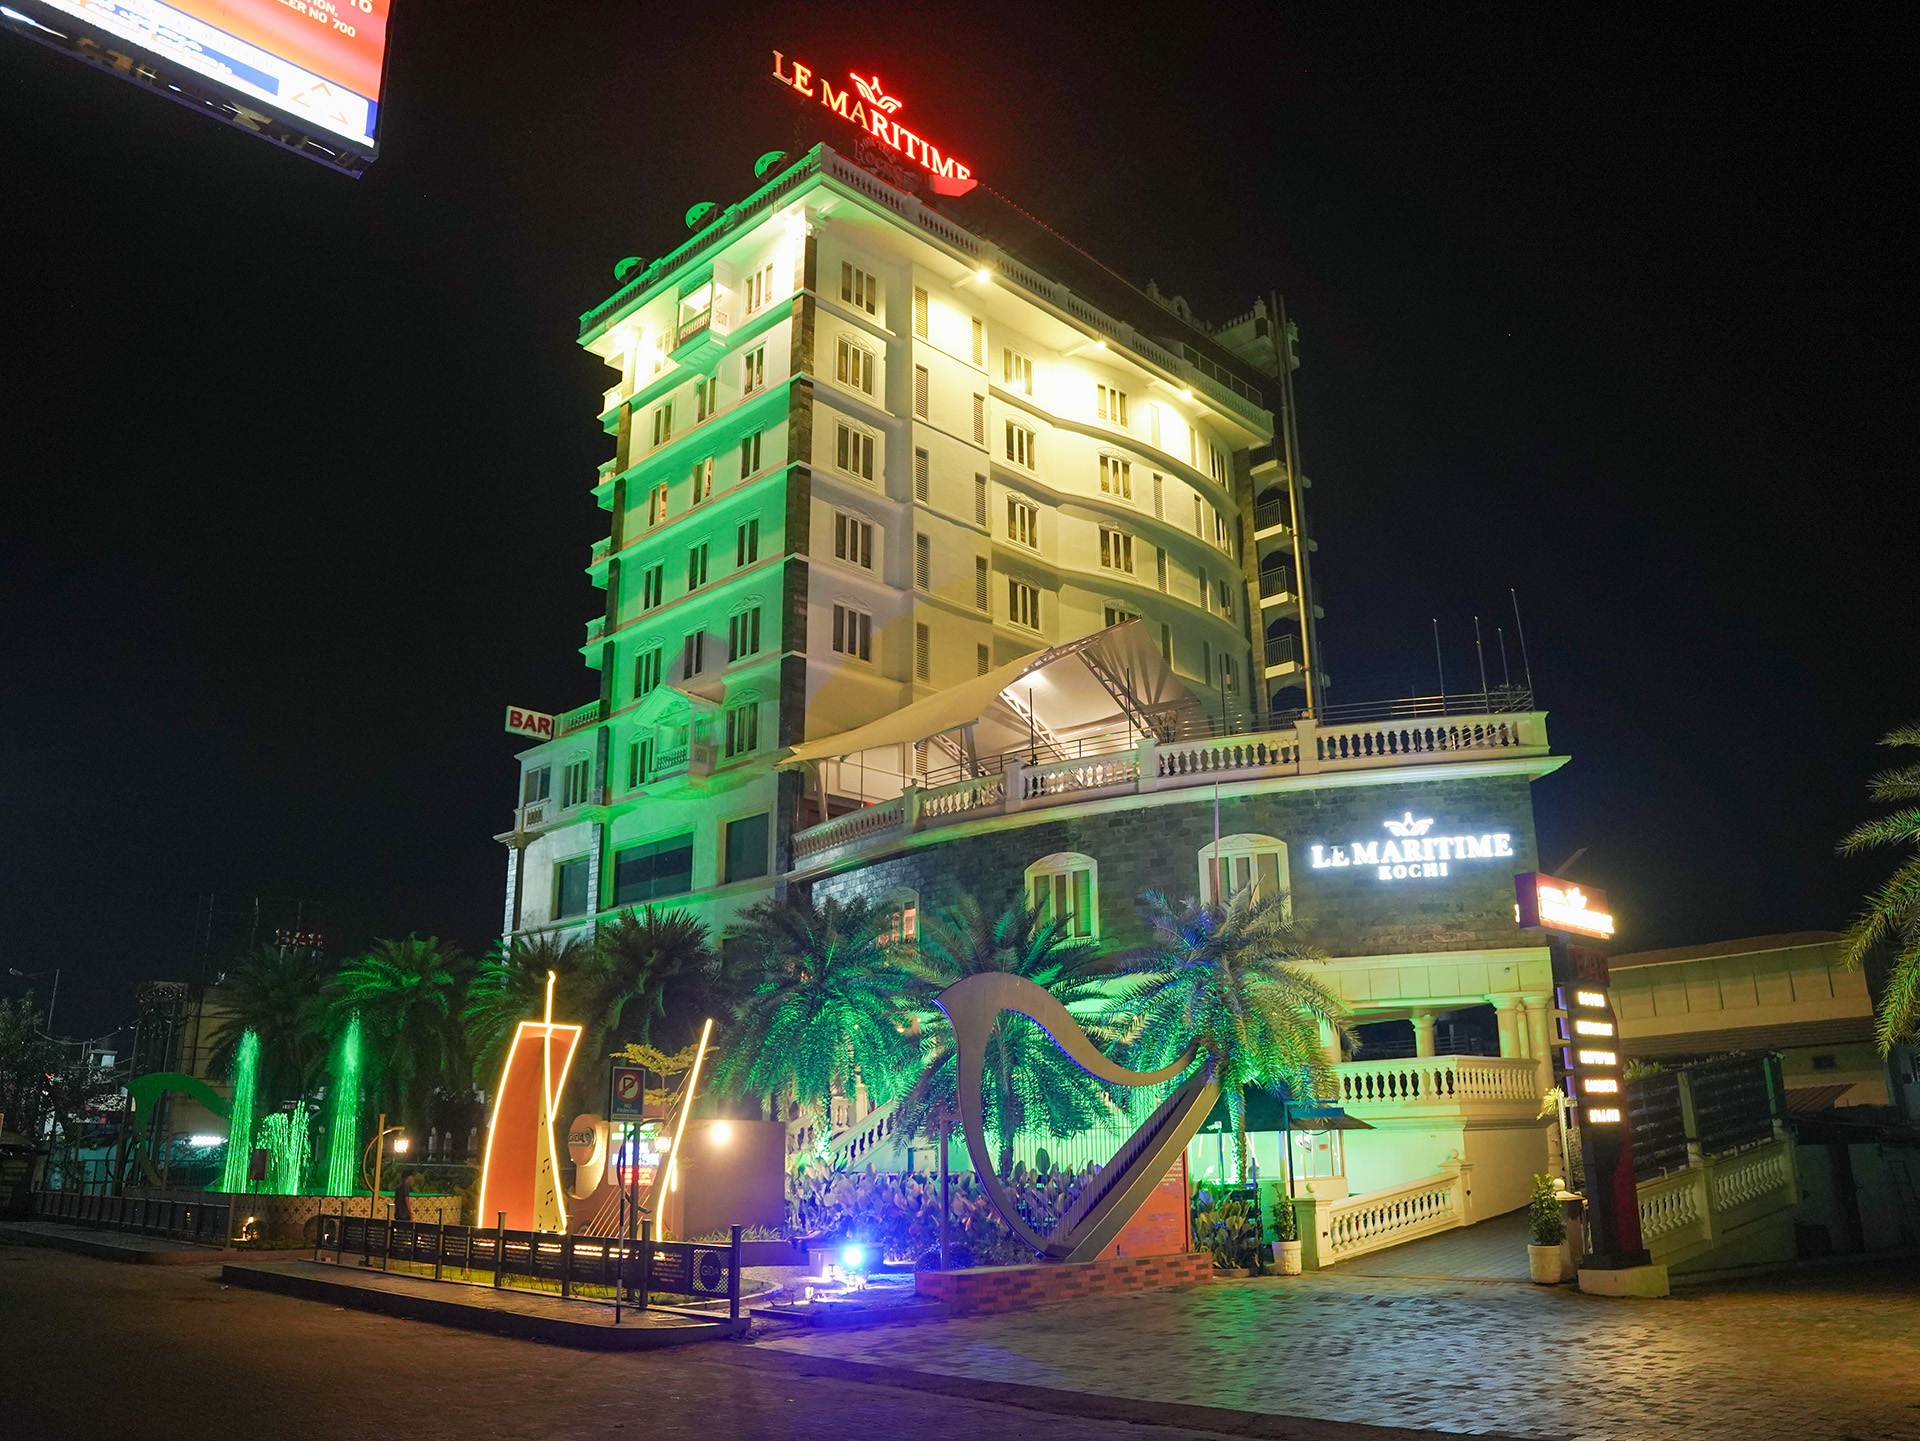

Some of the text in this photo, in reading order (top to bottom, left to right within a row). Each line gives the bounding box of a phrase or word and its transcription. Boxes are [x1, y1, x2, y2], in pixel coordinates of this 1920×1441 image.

[309, 6, 328, 23] NO
[332, 18, 356, 37] 700
[772, 50, 972, 181] LE MARITIME
[509, 709, 551, 735] BAR
[1311, 833, 1513, 868] LE MARITIME
[1378, 862, 1448, 880] KOCHI
[1573, 946, 1611, 982] BAR
